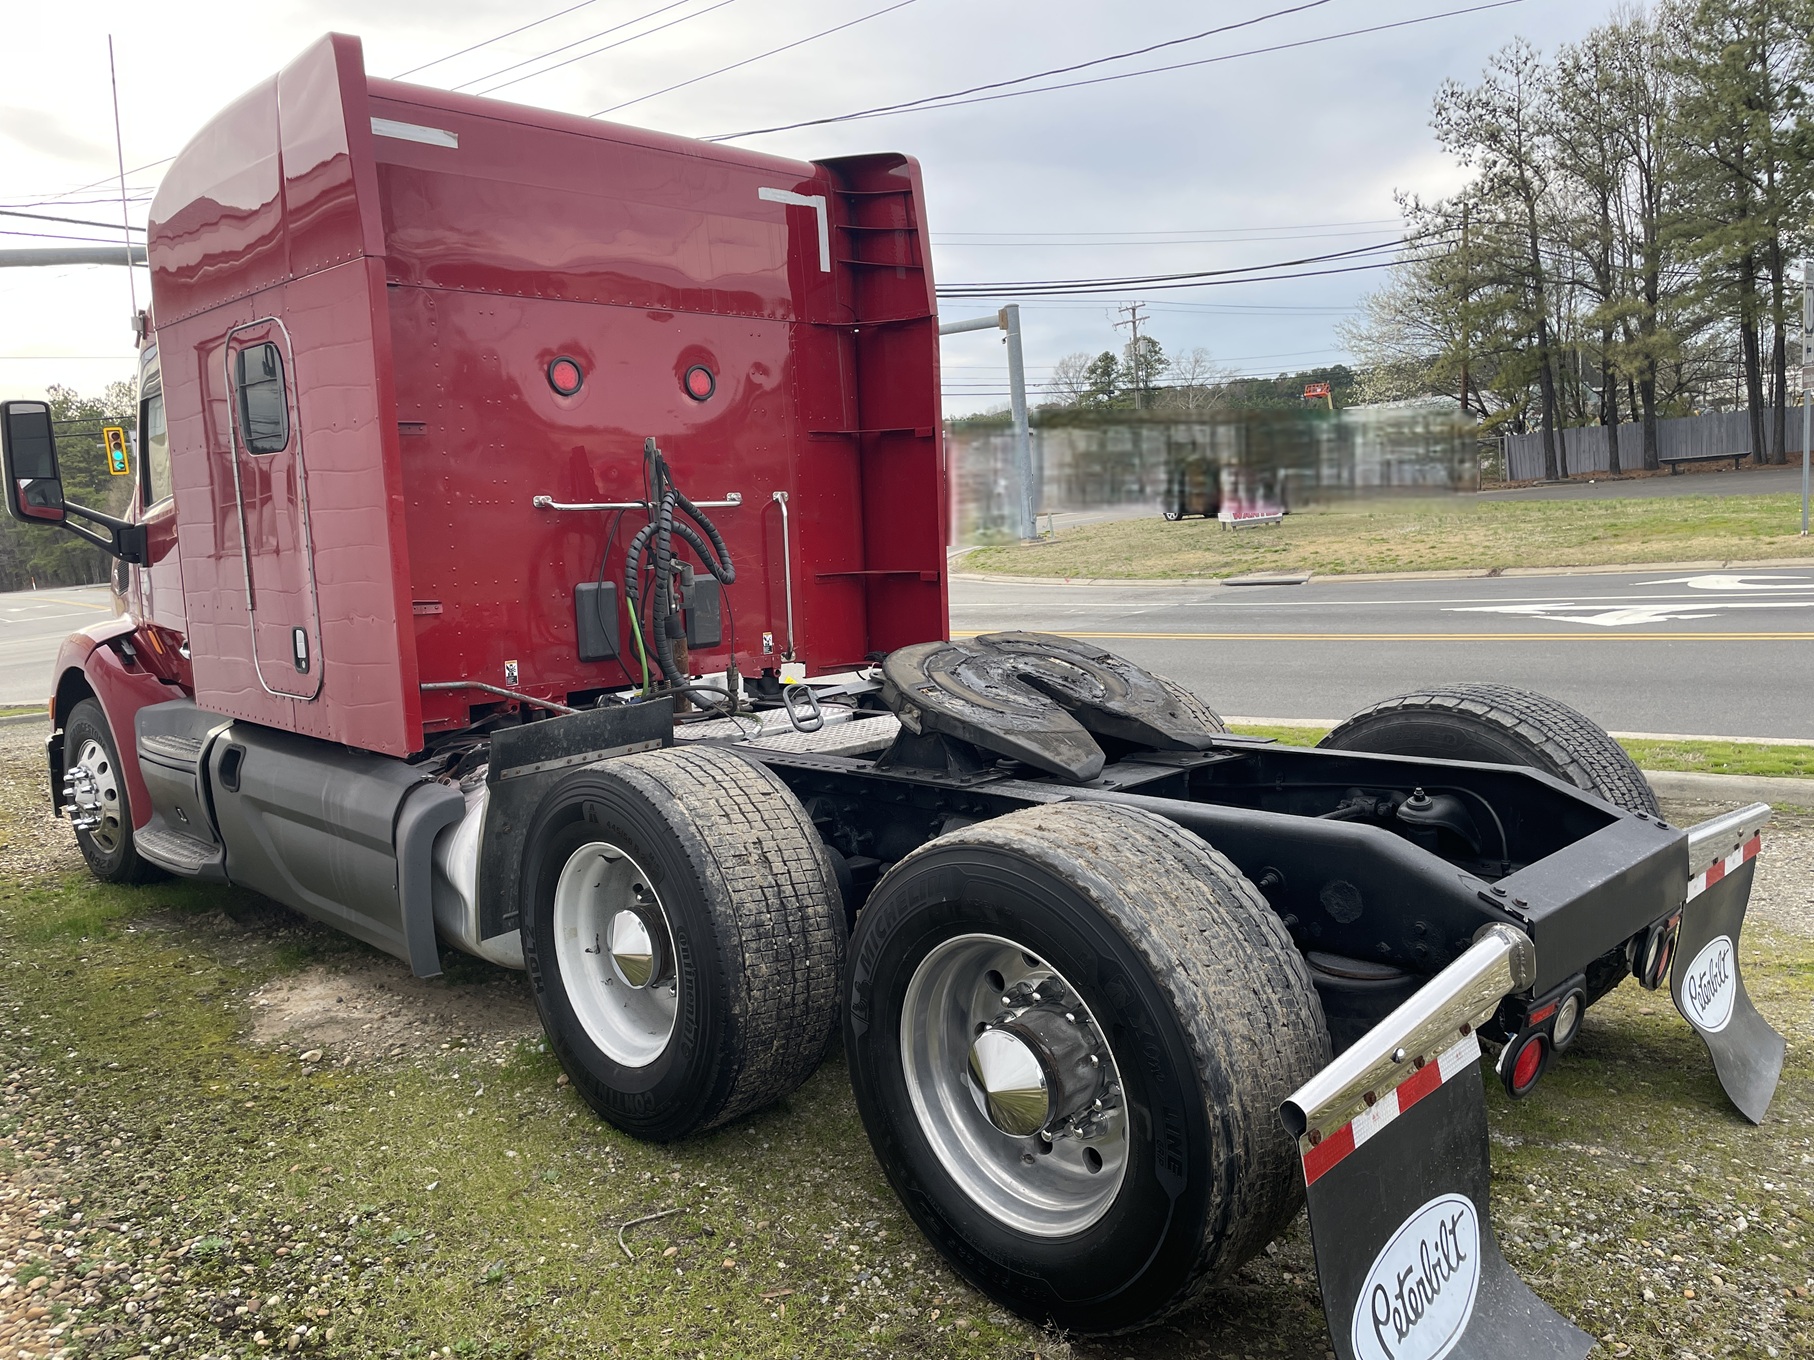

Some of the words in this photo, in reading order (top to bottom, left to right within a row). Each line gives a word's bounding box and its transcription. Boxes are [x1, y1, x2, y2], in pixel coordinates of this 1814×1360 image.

[606, 821, 633, 846] 445/50
[525, 924, 545, 995] HDL2
[860, 874, 950, 972] MICHELIN
[676, 927, 698, 1049] Continental
[1688, 947, 1730, 1021] Peterbilt
[1155, 1138, 1166, 1168] GRIP
[1162, 1105, 1183, 1179] LINE
[1371, 1209, 1467, 1360] Peterbilt
